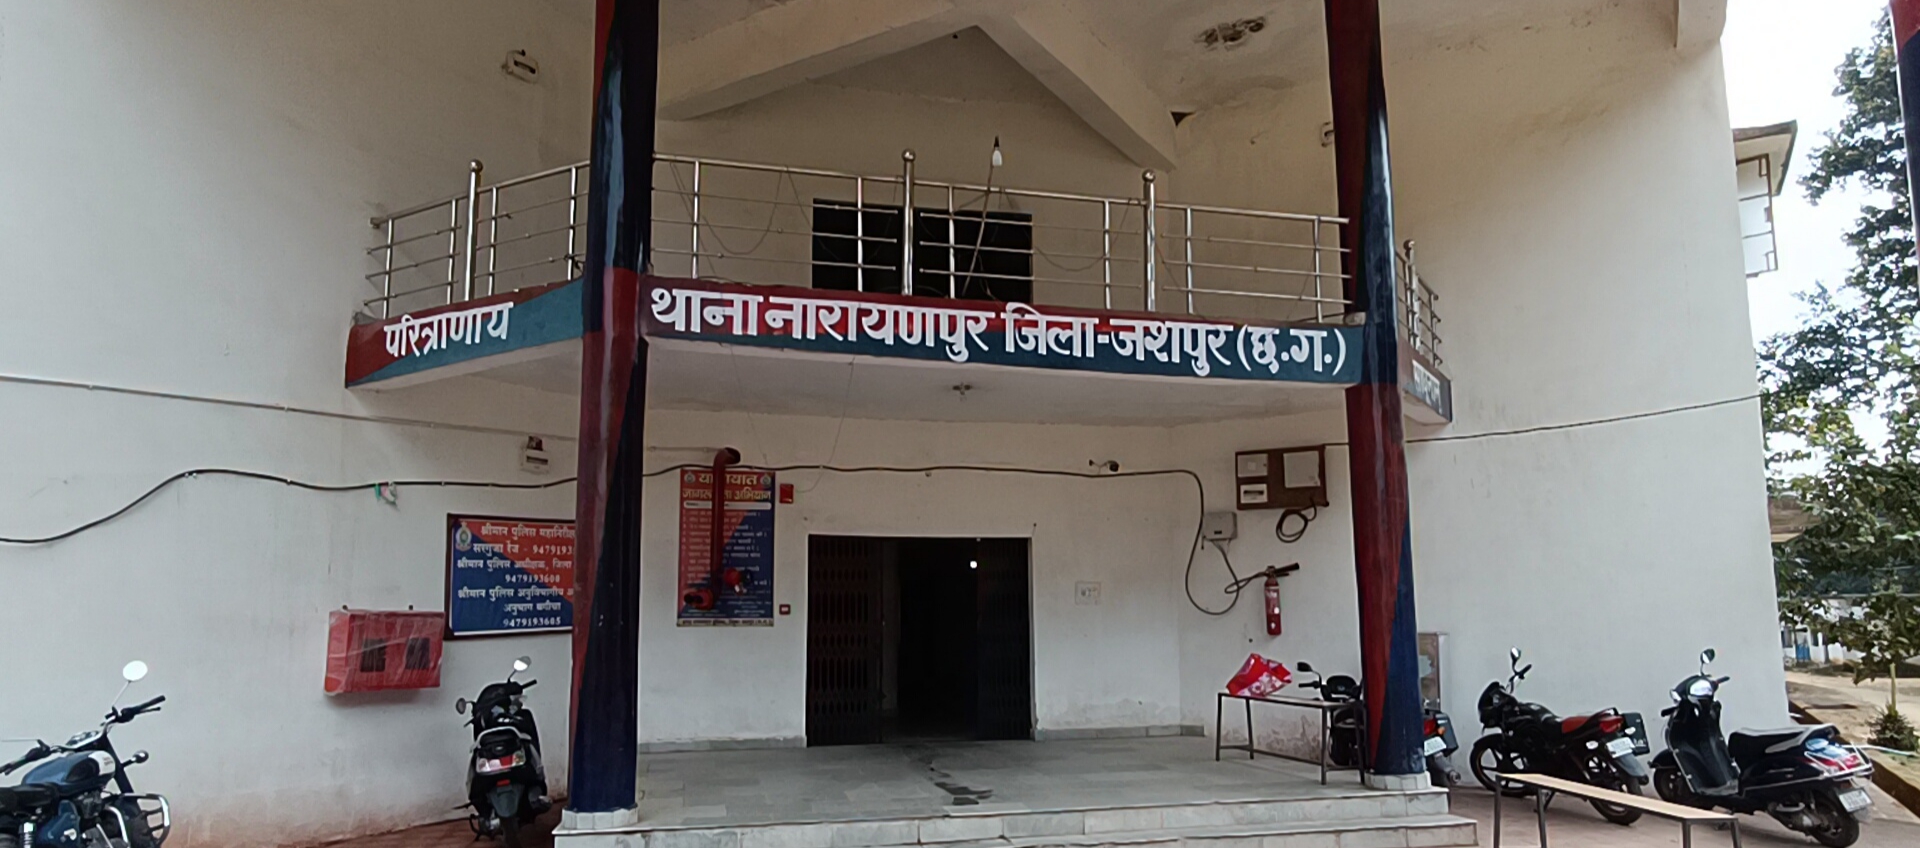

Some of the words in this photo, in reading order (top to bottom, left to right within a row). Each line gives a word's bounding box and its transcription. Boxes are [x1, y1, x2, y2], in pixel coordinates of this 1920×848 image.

[384, 302, 514, 357] परित्राणाय
[651, 287, 763, 337] थाना
[765, 296, 995, 363] नारायणपुर
[699, 473, 757, 485] याायात
[734, 486, 771, 500] अभियान
[481, 522, 508, 536] श्रीमान
[511, 523, 537, 540] पुलिस
[532, 544, 573, 555] 9479193
[457, 556, 484, 569] श्रीमान
[486, 556, 511, 572] पुलिस
[552, 557, 572, 569] जिला
[457, 586, 486, 598] श्रीमान
[489, 585, 515, 601] पुलिस
[503, 602, 533, 615] अनुभाग
